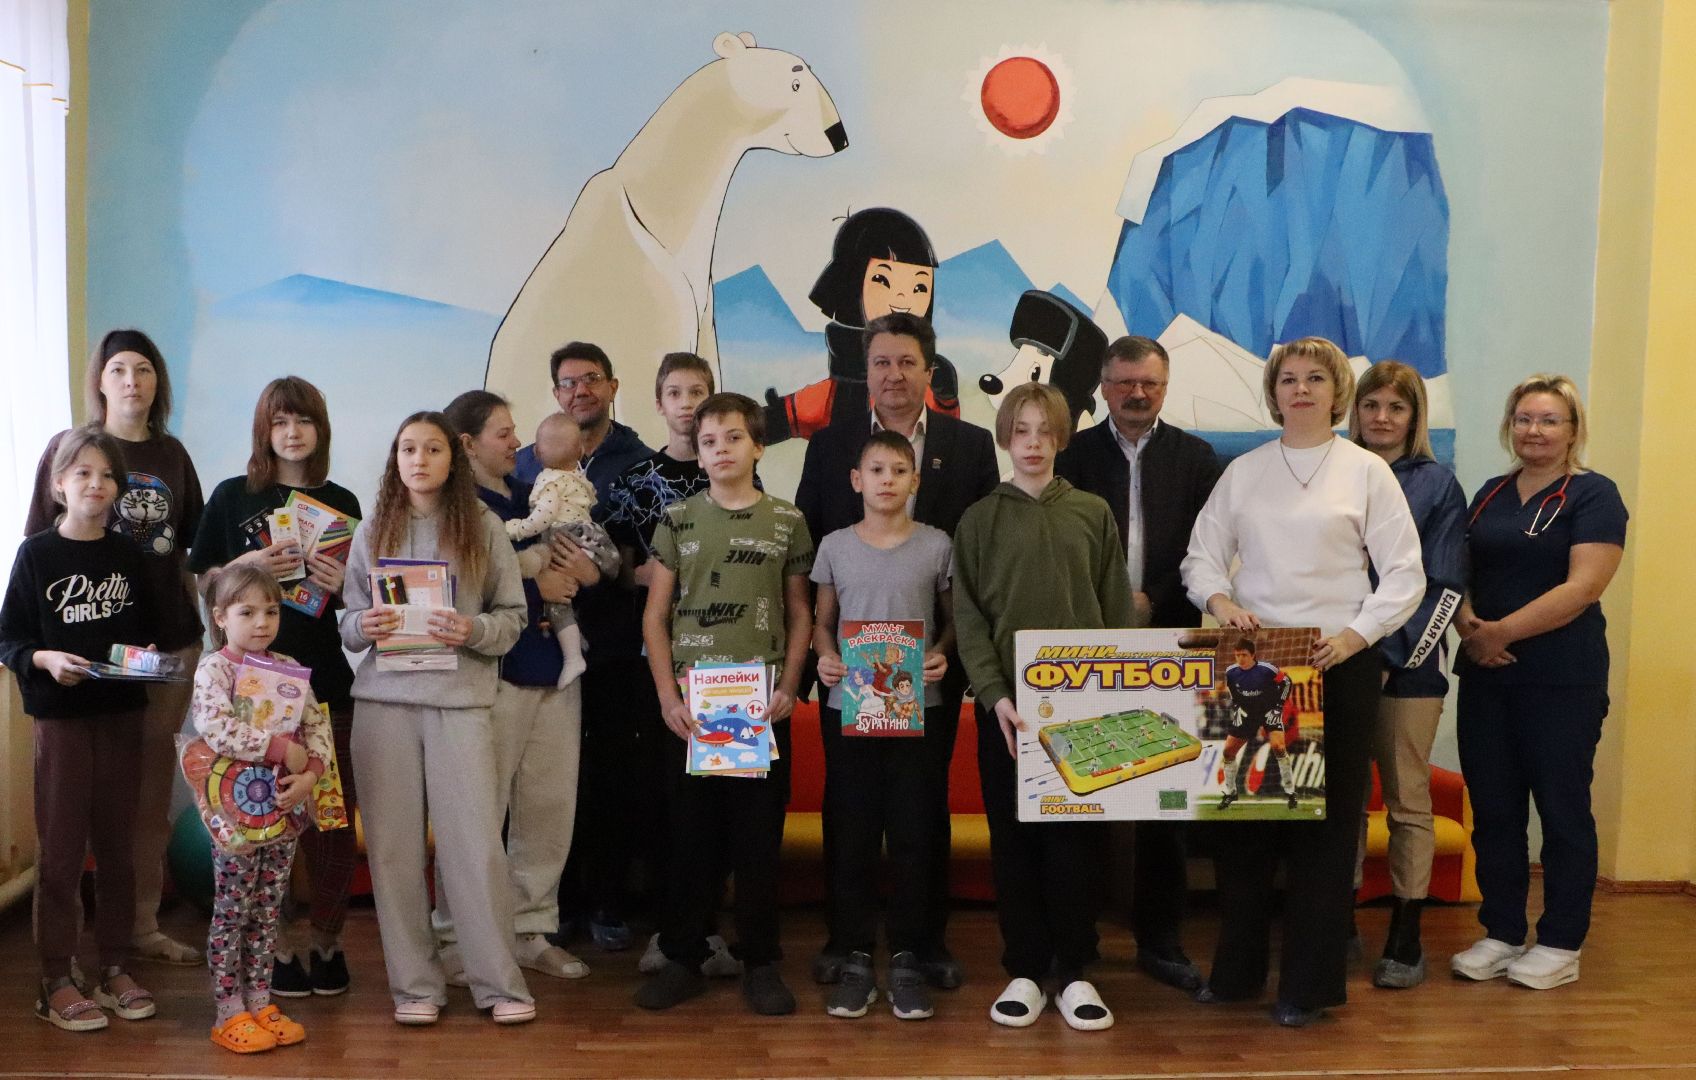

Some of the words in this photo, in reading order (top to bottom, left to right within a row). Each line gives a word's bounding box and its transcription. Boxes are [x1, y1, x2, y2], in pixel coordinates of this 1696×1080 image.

[723, 549, 767, 565] NIKE
[46, 572, 134, 613] Pretty
[300, 592, 308, 600] 16
[63, 601, 112, 623] GIRLS
[1427, 593, 1456, 639] ЕДИНАЯ
[861, 623, 905, 634] МУЛЬТ
[848, 633, 917, 649] РАСКРАСКА
[694, 671, 760, 685] Наклейки
[1023, 659, 1215, 691] ФУТБОЛ
[749, 704, 763, 715] 1+
[1040, 804, 1104, 815] FOOTBALL
